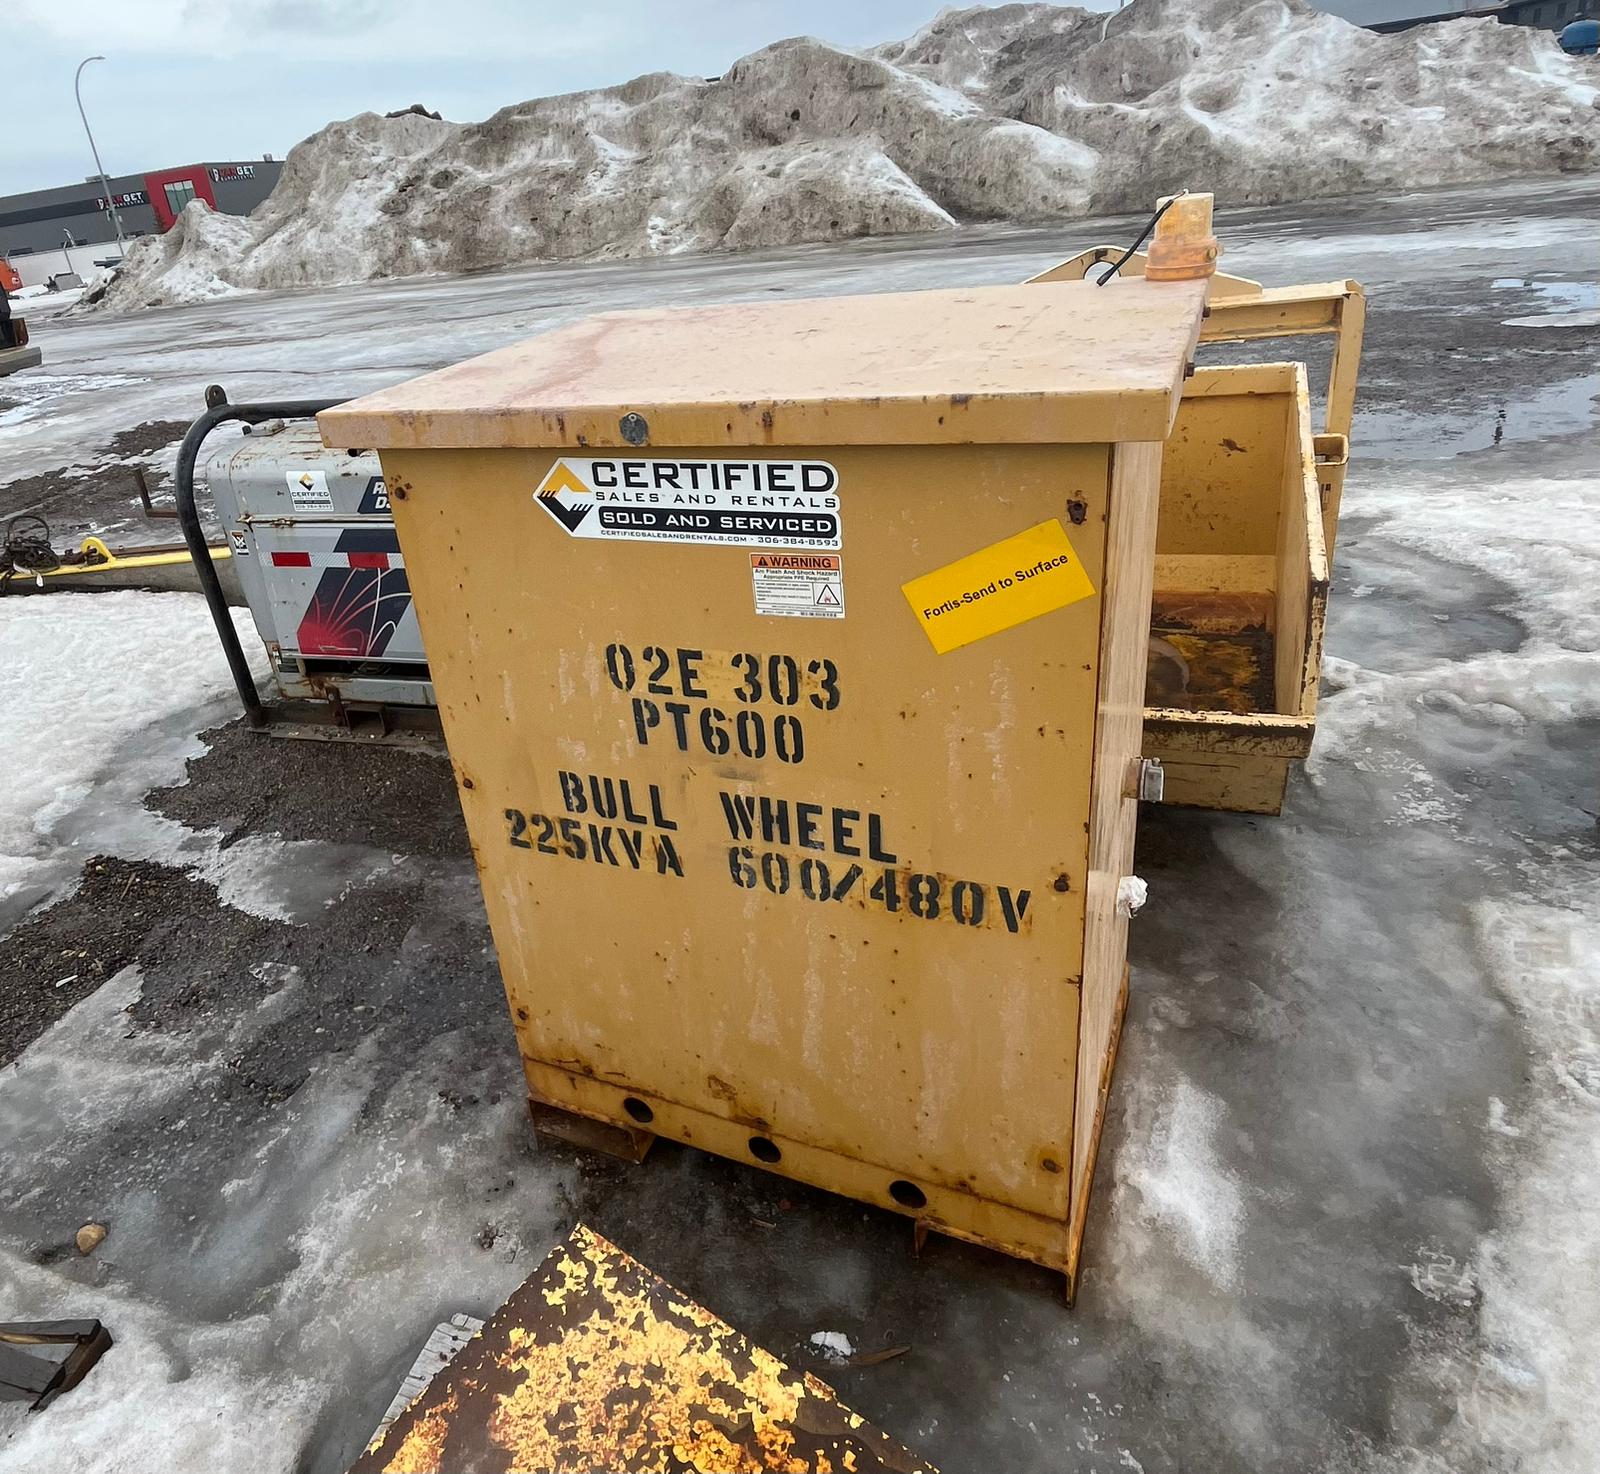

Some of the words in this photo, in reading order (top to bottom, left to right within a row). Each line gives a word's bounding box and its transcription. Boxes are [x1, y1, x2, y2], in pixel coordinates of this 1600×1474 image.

[592, 462, 834, 492] CERTIFIED
[596, 491, 660, 503] SALES
[673, 494, 717, 504] AND
[731, 495, 836, 508] RENTALS
[603, 512, 656, 525] SOLD
[666, 514, 710, 527] AND
[720, 516, 832, 532] SERVICED
[758, 536, 839, 547] 306-384-8593
[769, 556, 832, 568] WARNING
[923, 582, 998, 620] Fortis-Send
[998, 576, 1013, 589] to
[1015, 554, 1069, 582] Surface
[606, 643, 708, 699] 02E
[731, 653, 841, 711] 303
[632, 698, 805, 764] PT600
[558, 770, 678, 832] BULL
[719, 792, 898, 864] WHEEL
[505, 808, 685, 878] 225KVA
[728, 847, 1032, 933] 600/480V
